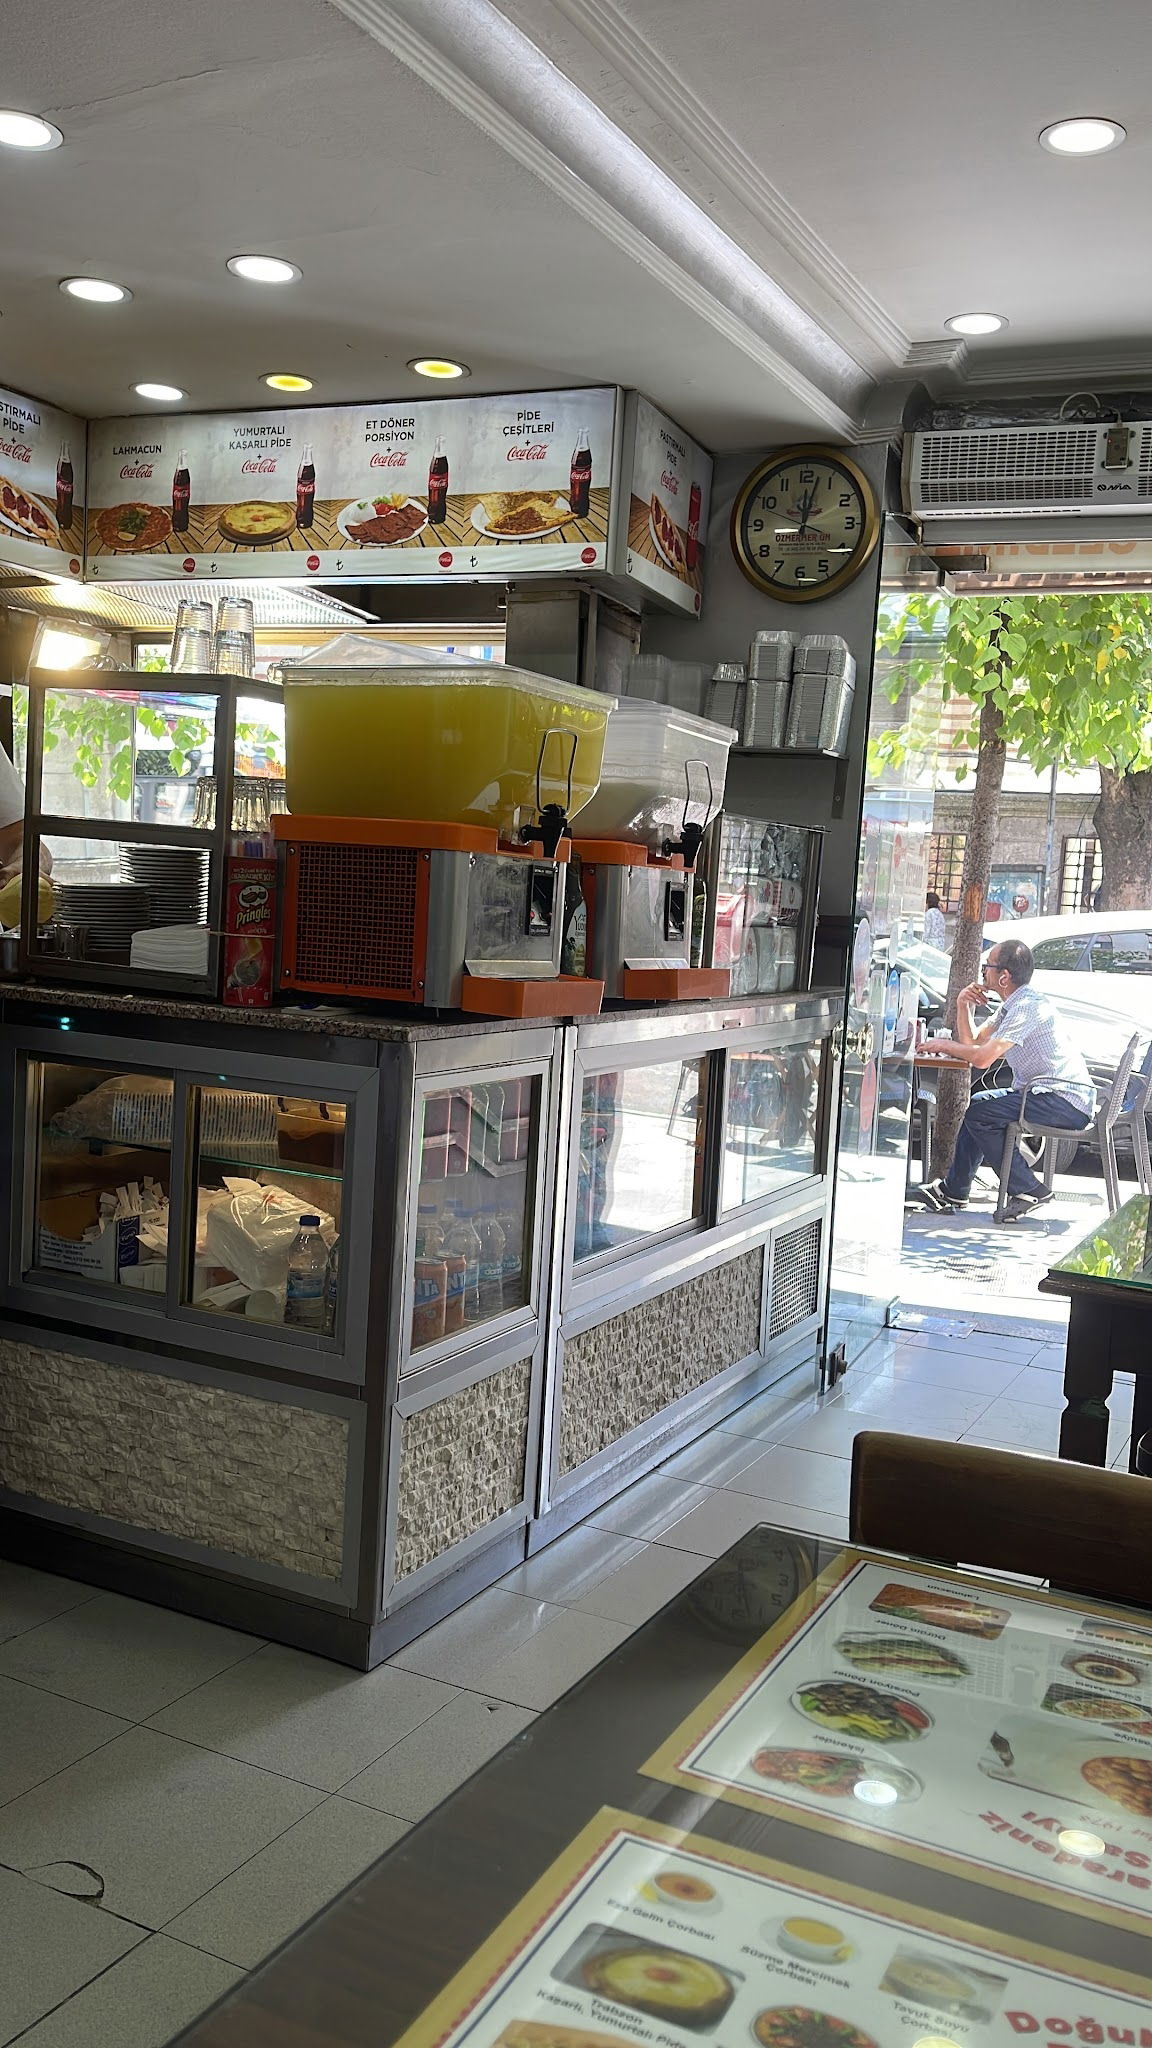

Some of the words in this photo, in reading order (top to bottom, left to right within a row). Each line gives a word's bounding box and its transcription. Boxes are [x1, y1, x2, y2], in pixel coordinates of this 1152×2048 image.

[517, 410, 541, 421] PİDE
[3, 417, 25, 434] PİDE
[366, 420, 378, 430] ET
[380, 417, 415, 429] DÖNER
[502, 423, 554, 437] ÇEŞİTLERİ
[233, 426, 285, 437] YUMURTALI
[365, 432, 415, 443] PORSİYON
[113, 445, 162, 456] LAHMACUN
[229, 439, 268, 451] KAŞARLI
[271, 437, 292, 448] PİDE
[369, 452, 408, 467] Coca-Cola
[506, 444, 548, 462] Coca-Cola
[120, 464, 154, 479] Coca-Cola
[241, 458, 278, 474] Coca-Cola
[780, 478, 789, 491] 11
[828, 477, 832, 490] 1
[800, 470, 814, 483] 12
[762, 496, 776, 509] 10
[839, 494, 850, 507] 2
[754, 519, 763, 531] 9
[844, 517, 855, 530] 3
[759, 544, 770, 557] 8
[774, 560, 784, 573] 7
[818, 559, 828, 572] 5
[795, 566, 805, 579] 6
[236, 905, 271, 929] Pringles
[926, 1584, 980, 1601] Lahmacun
[830, 1669, 867, 1685] Döner
[868, 1678, 922, 1698] Porsiyon
[633, 1906, 664, 1923] Gelin
[667, 1918, 716, 1941] Çorbası
[740, 1945, 784, 1965] Süzme
[787, 1961, 850, 1989] Mercimek
[766, 1963, 816, 1987] Çorbası
[591, 1998, 644, 2026] Trabzon
[893, 2000, 931, 2020] Tavuk
[934, 2015, 971, 2034] Suyu
[591, 2009, 653, 2041] Yumurtalı
